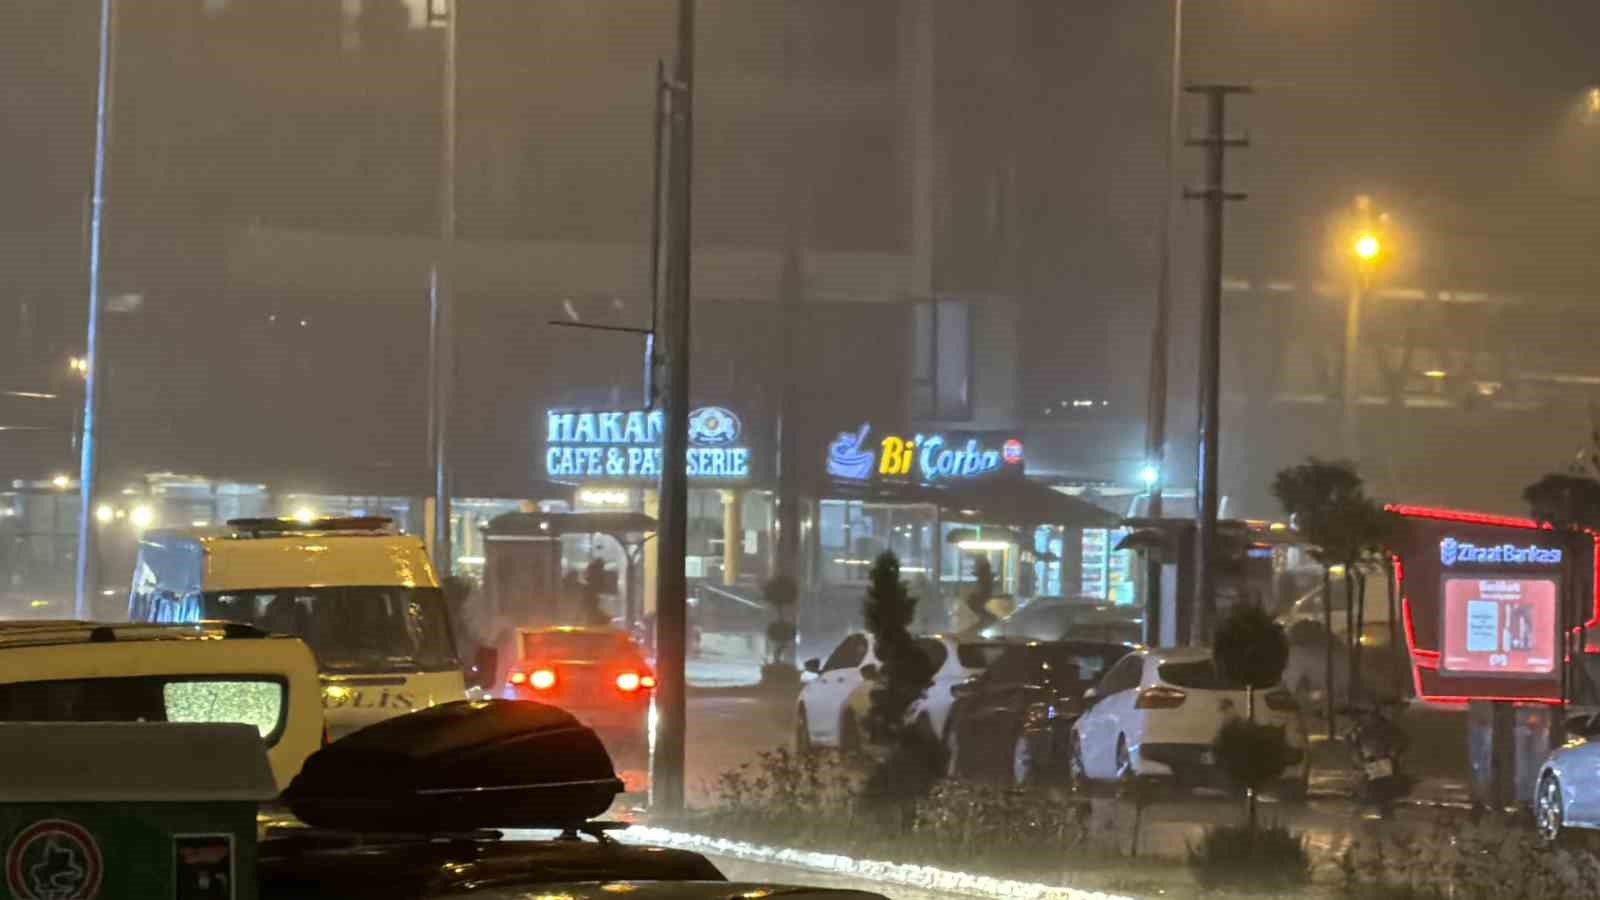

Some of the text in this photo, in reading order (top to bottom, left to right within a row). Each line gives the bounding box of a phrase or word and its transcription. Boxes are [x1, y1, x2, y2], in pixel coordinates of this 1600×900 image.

[546, 447, 602, 475] CAFE
[606, 447, 625, 475] &
[1457, 543, 1501, 562] Ziraat
